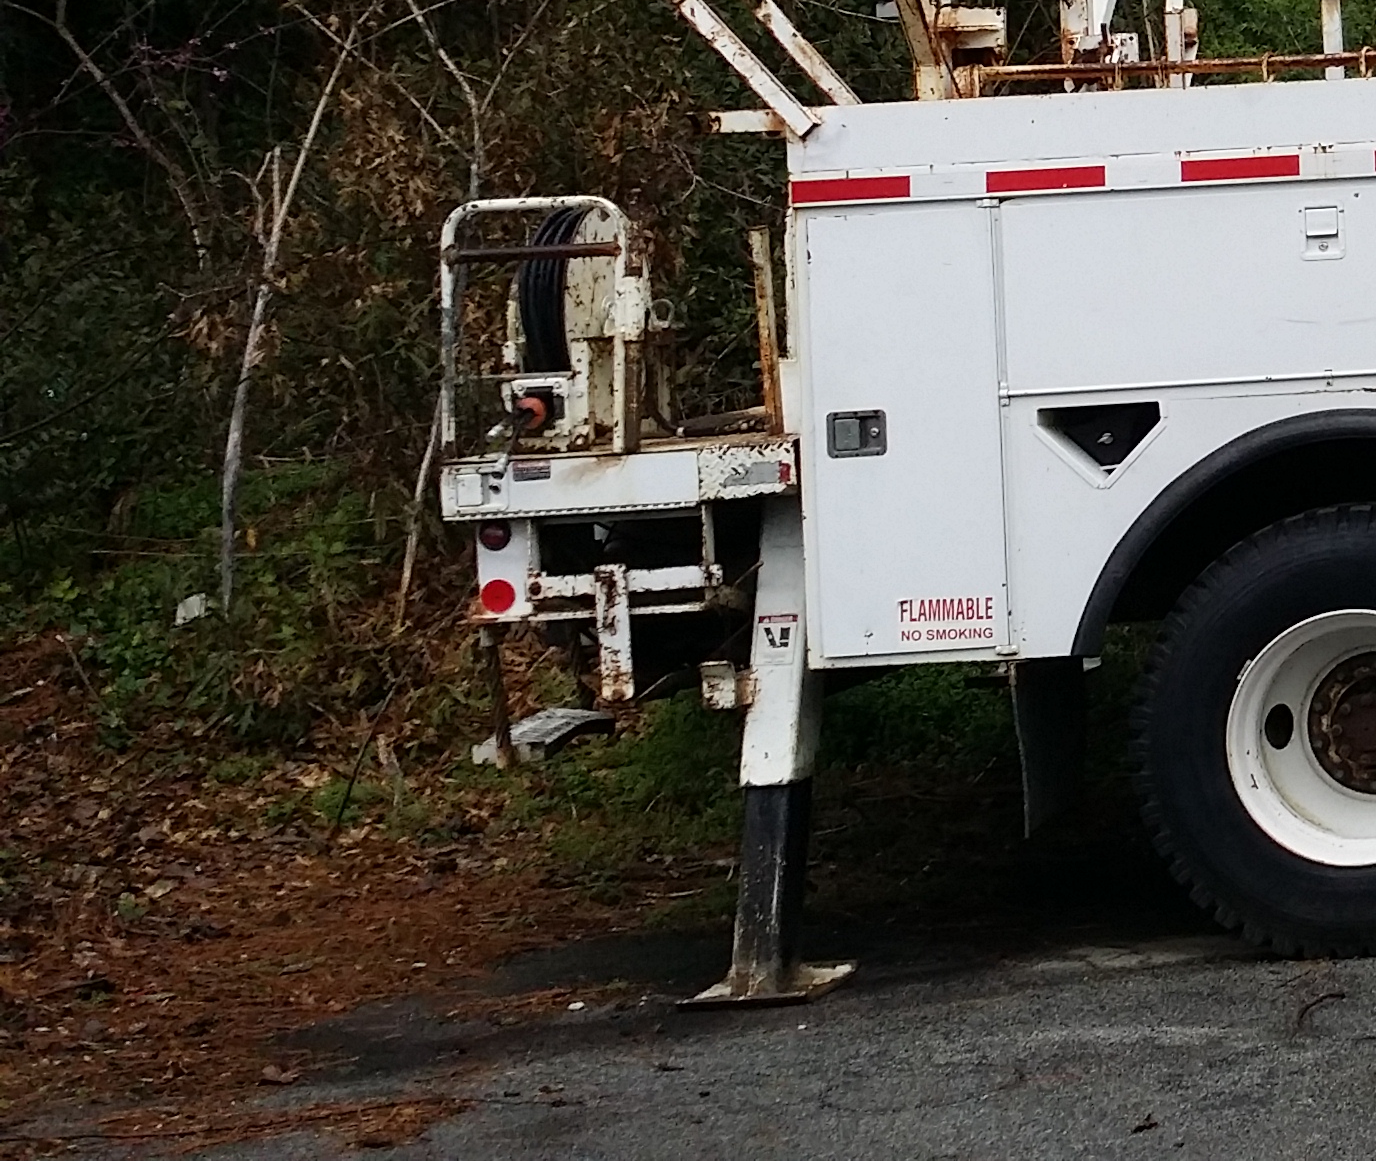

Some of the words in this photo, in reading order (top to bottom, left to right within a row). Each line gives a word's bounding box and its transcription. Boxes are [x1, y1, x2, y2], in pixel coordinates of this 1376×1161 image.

[899, 597, 993, 622] FLAMMABLE
[901, 630, 922, 641] NO
[926, 627, 993, 641] SMOKING
